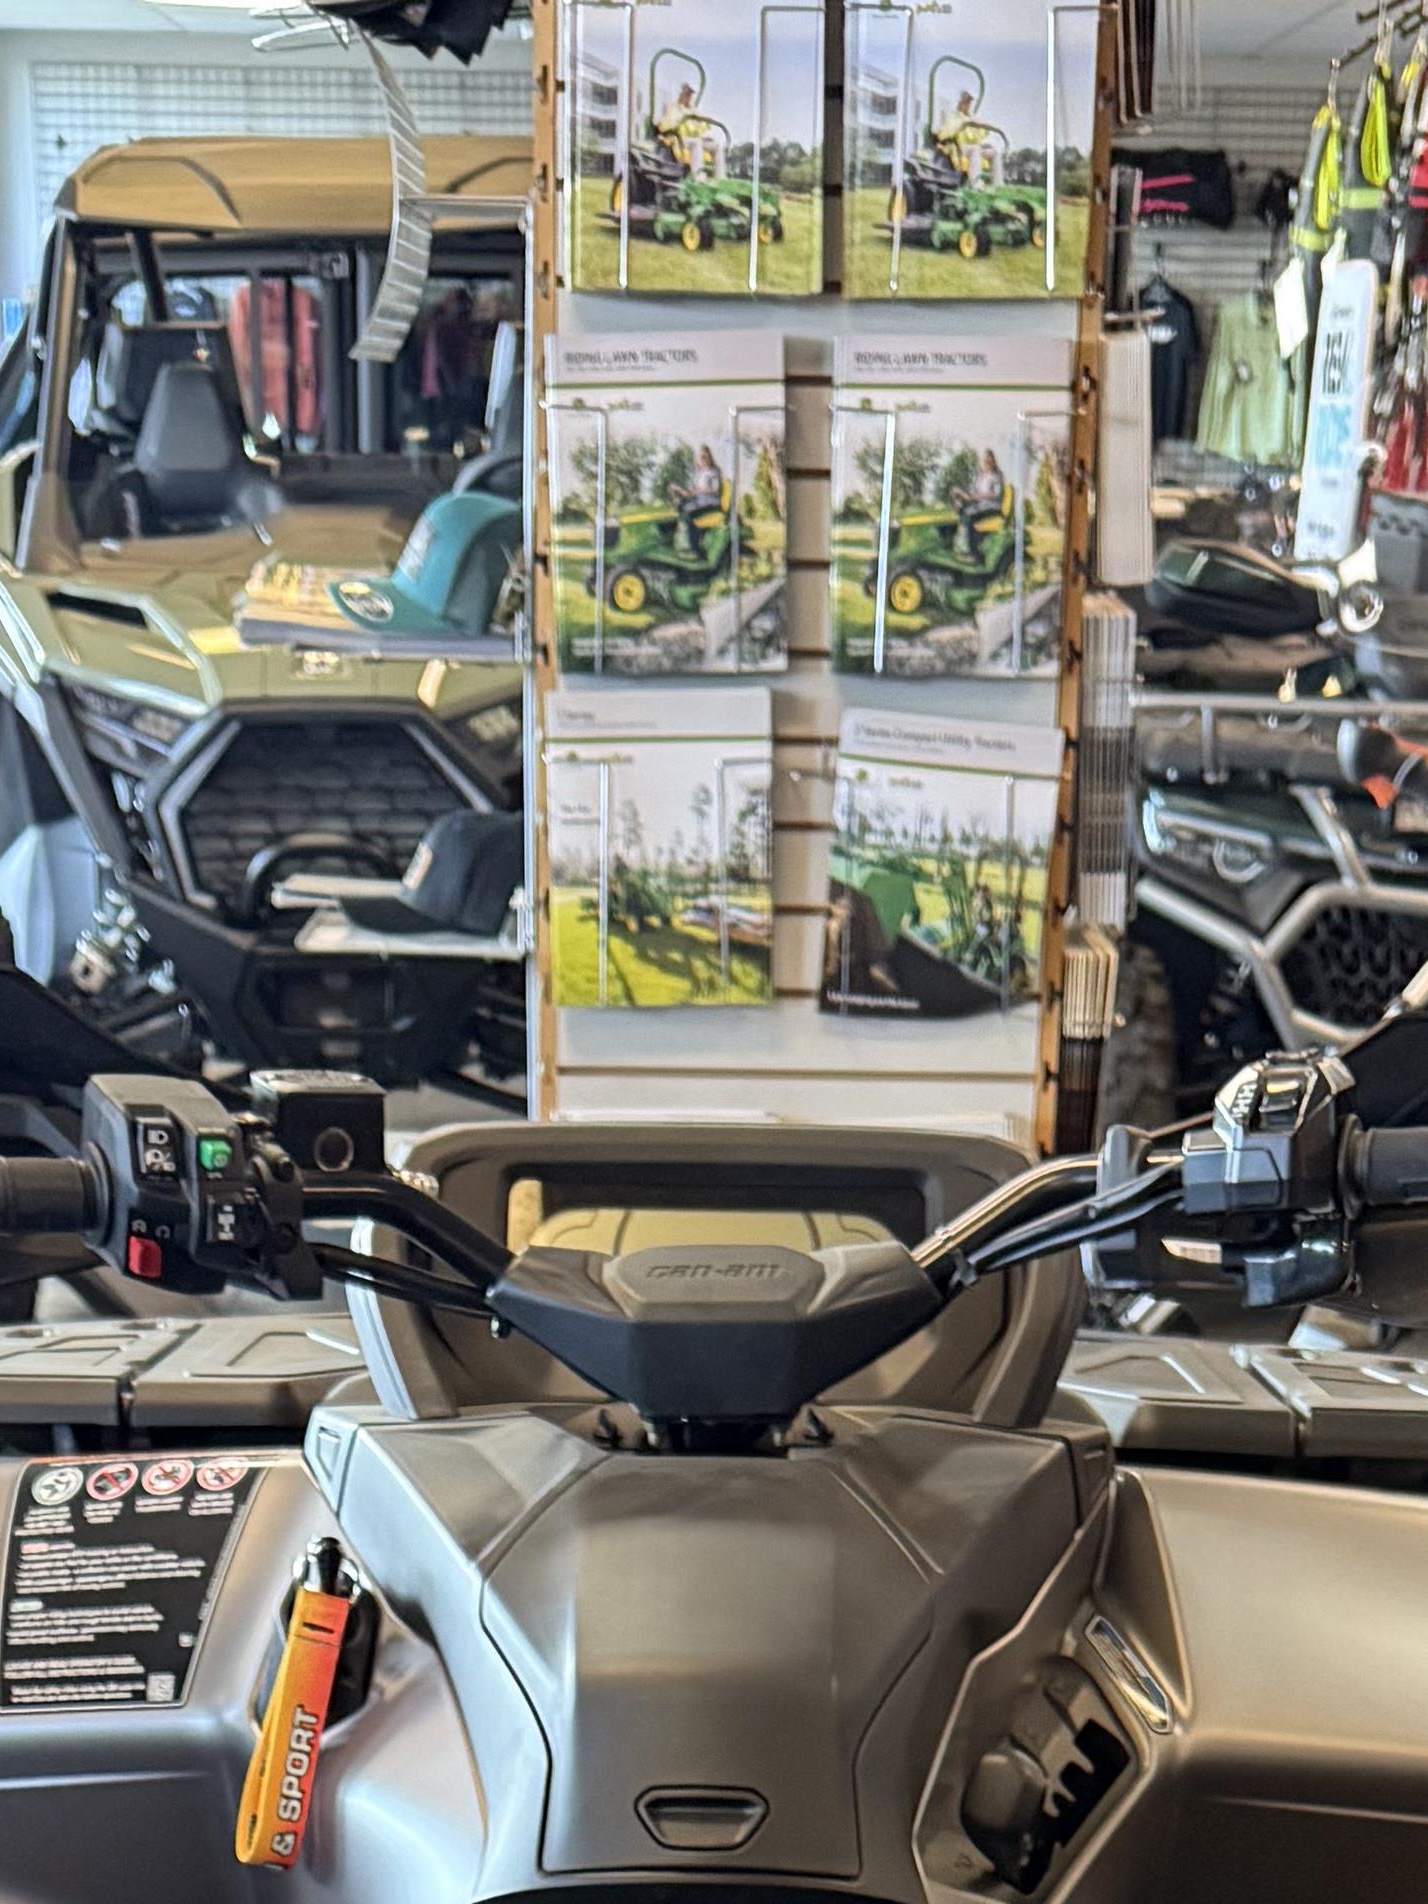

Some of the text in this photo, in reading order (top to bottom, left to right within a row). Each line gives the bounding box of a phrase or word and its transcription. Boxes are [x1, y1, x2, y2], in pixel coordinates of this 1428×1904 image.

[646, 1262, 784, 1280] can-am
[271, 1705, 320, 1858] & SPORT
